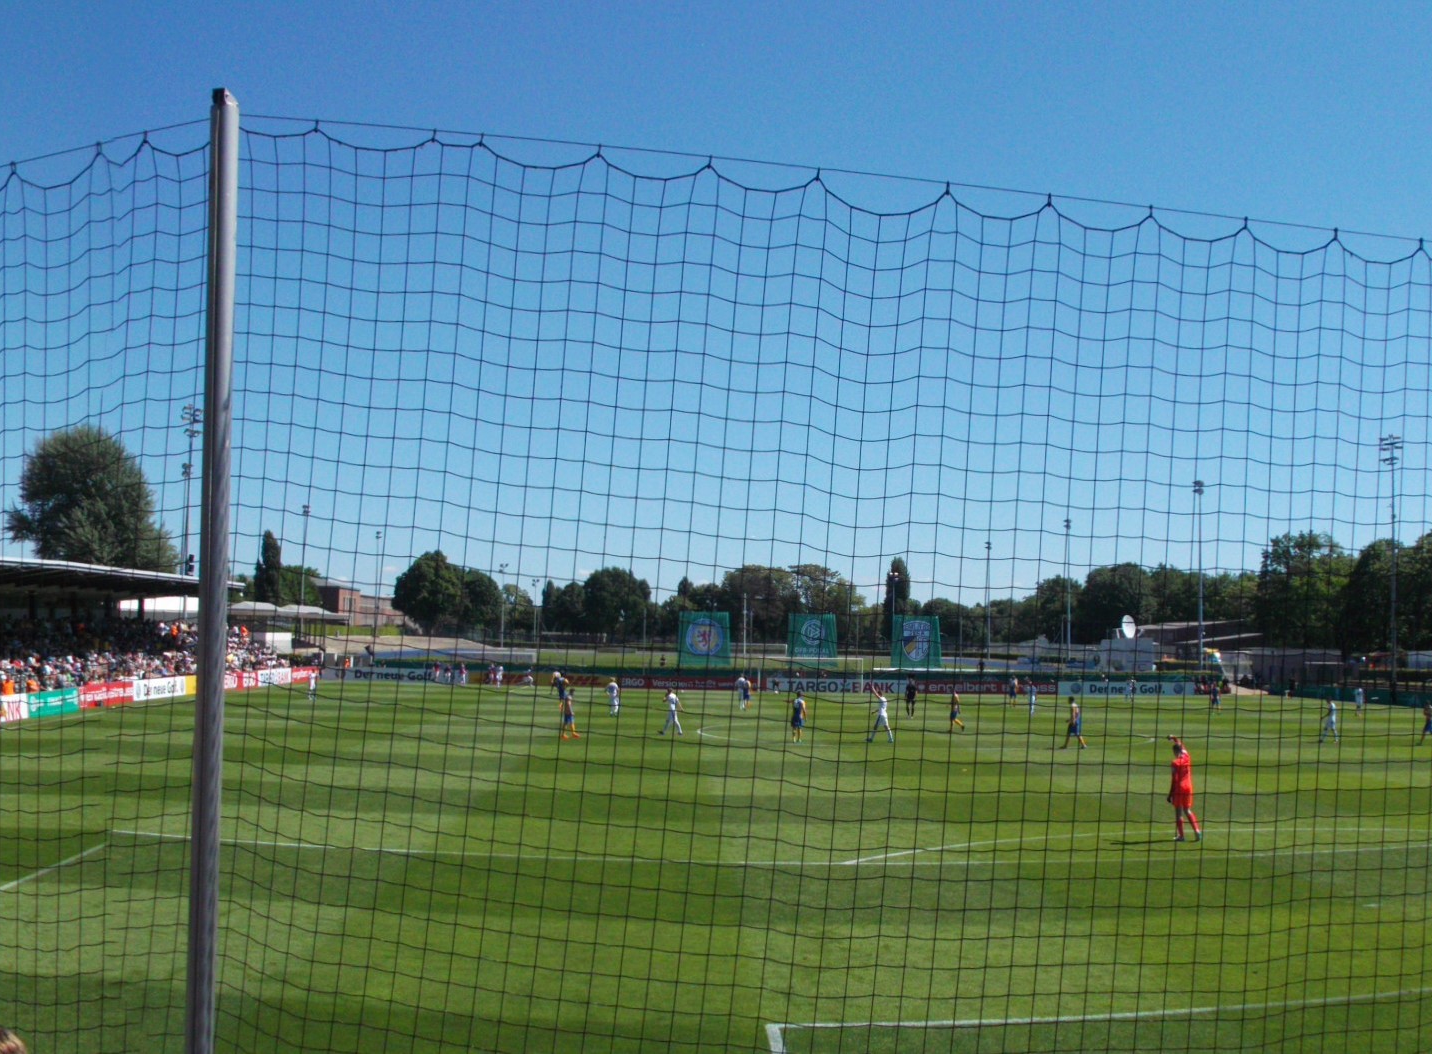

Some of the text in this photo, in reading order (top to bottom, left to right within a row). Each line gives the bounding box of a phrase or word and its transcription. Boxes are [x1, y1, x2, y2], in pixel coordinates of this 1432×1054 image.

[786, 680, 895, 694] TARGO BANK
[1089, 684, 1109, 694] Der
[1111, 686, 1136, 694] nee
